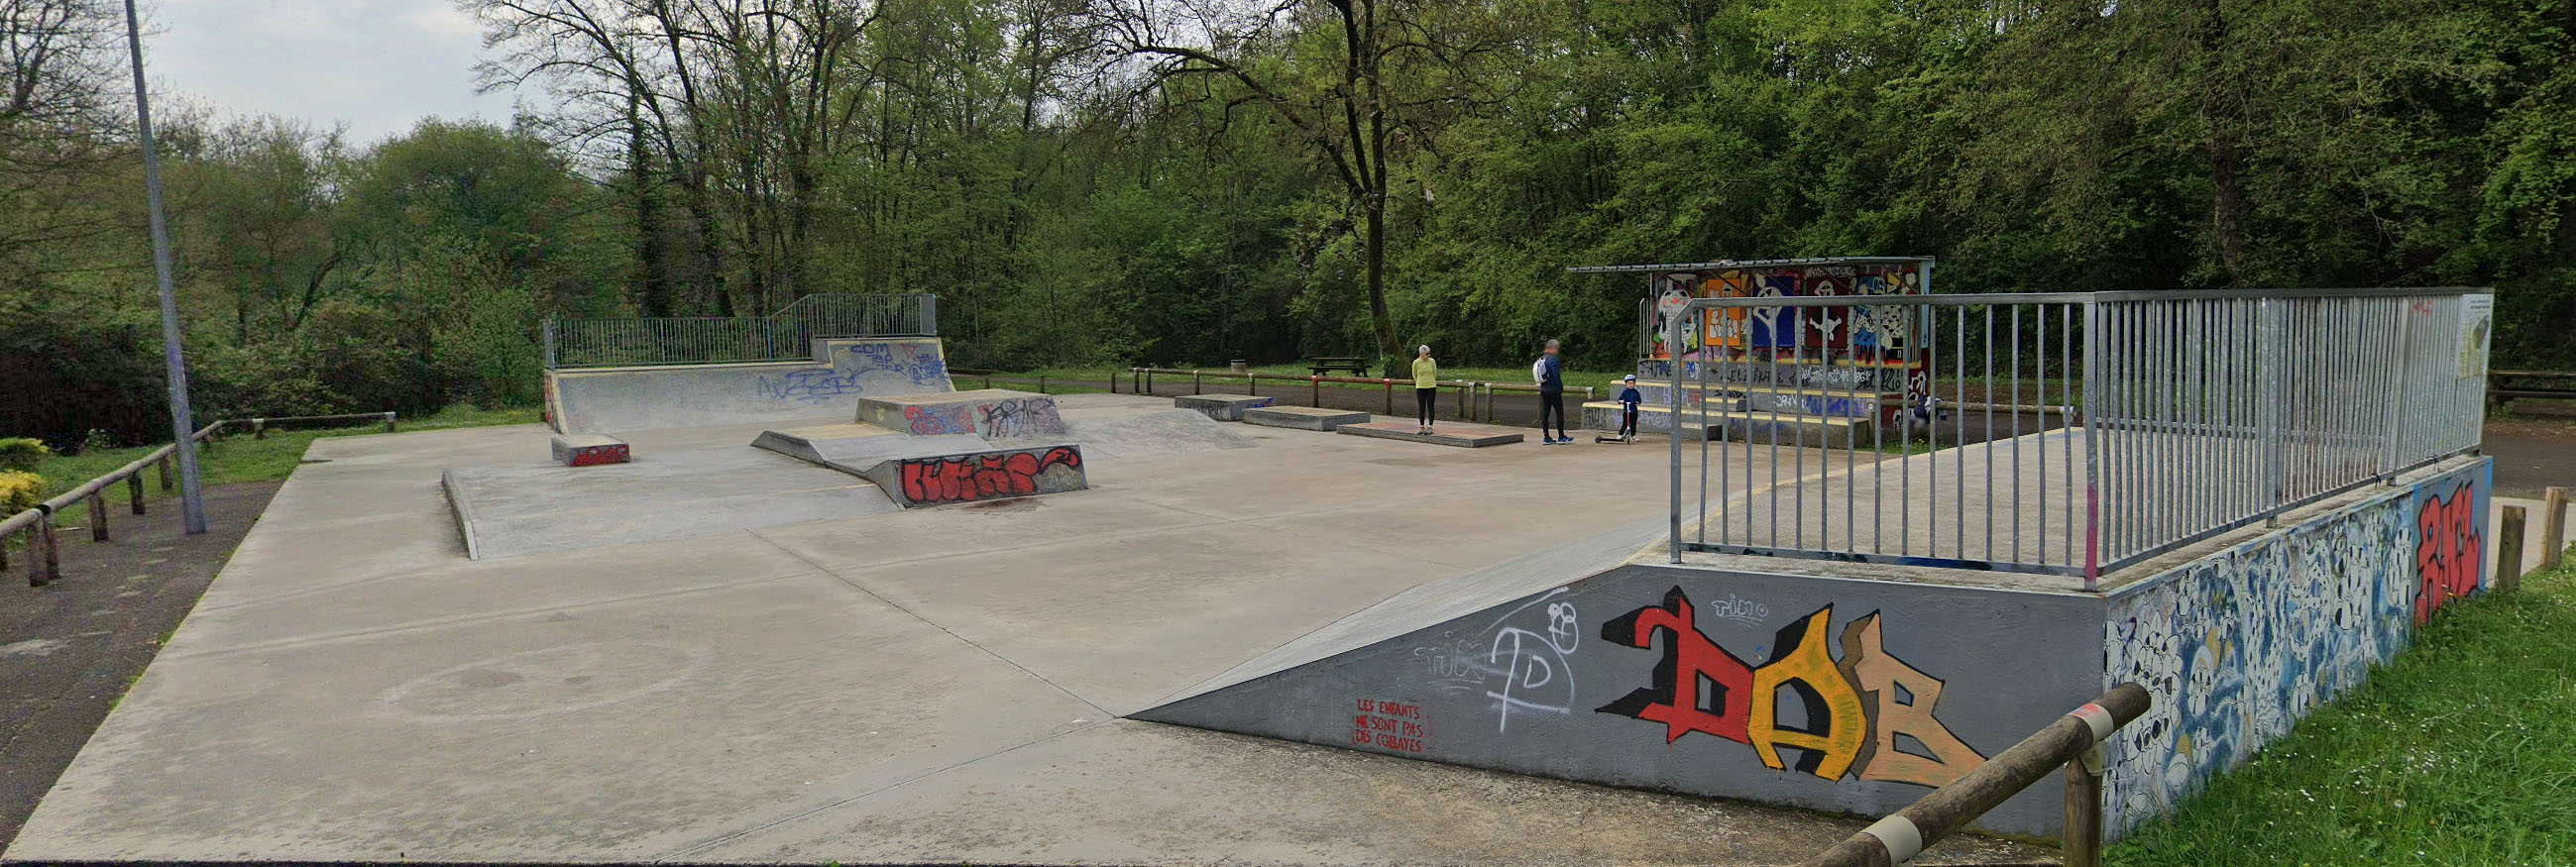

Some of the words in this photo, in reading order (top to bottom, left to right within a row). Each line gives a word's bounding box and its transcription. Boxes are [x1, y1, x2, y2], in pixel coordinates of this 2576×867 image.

[1595, 585, 1989, 789] DAB
[1358, 699, 1376, 712] LES
[1379, 701, 1420, 720] ENFANTS
[1372, 715, 1398, 733] SONT
[1402, 720, 1424, 738] PAS
[1356, 728, 1373, 744] DES
[1376, 733, 1421, 753] COBAYES
